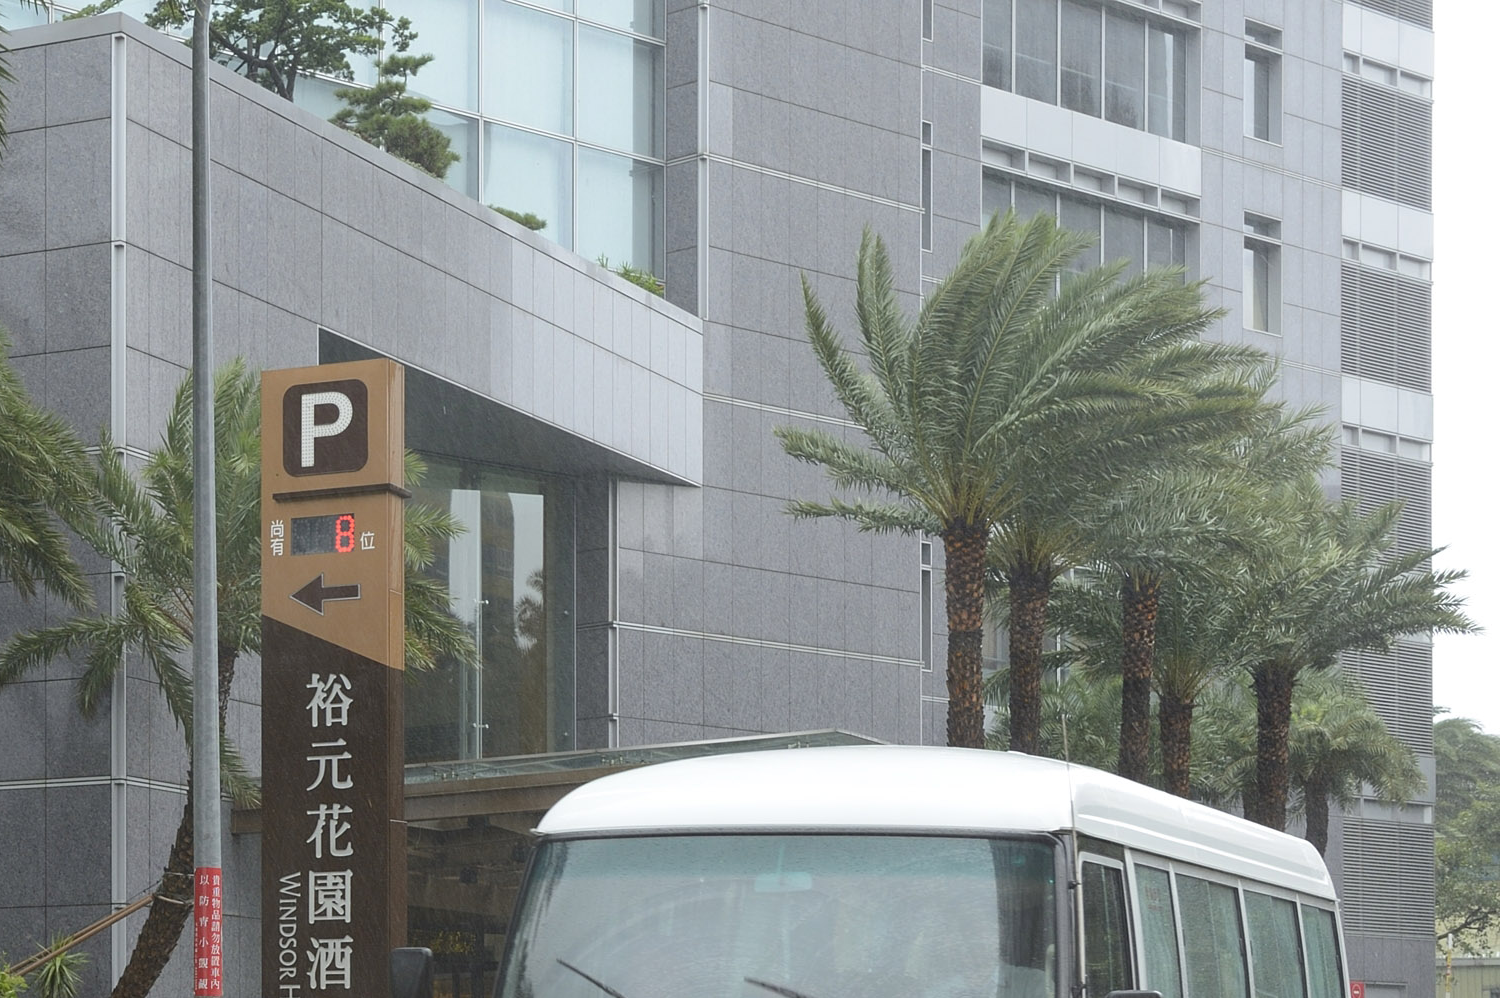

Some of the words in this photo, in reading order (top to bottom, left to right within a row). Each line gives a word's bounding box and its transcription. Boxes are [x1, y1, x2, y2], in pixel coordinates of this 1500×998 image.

[300, 390, 353, 468] P
[270, 519, 285, 556] 尚有
[335, 514, 355, 552] 8
[359, 531, 375, 550] 位
[279, 871, 301, 980] WINDSOR
